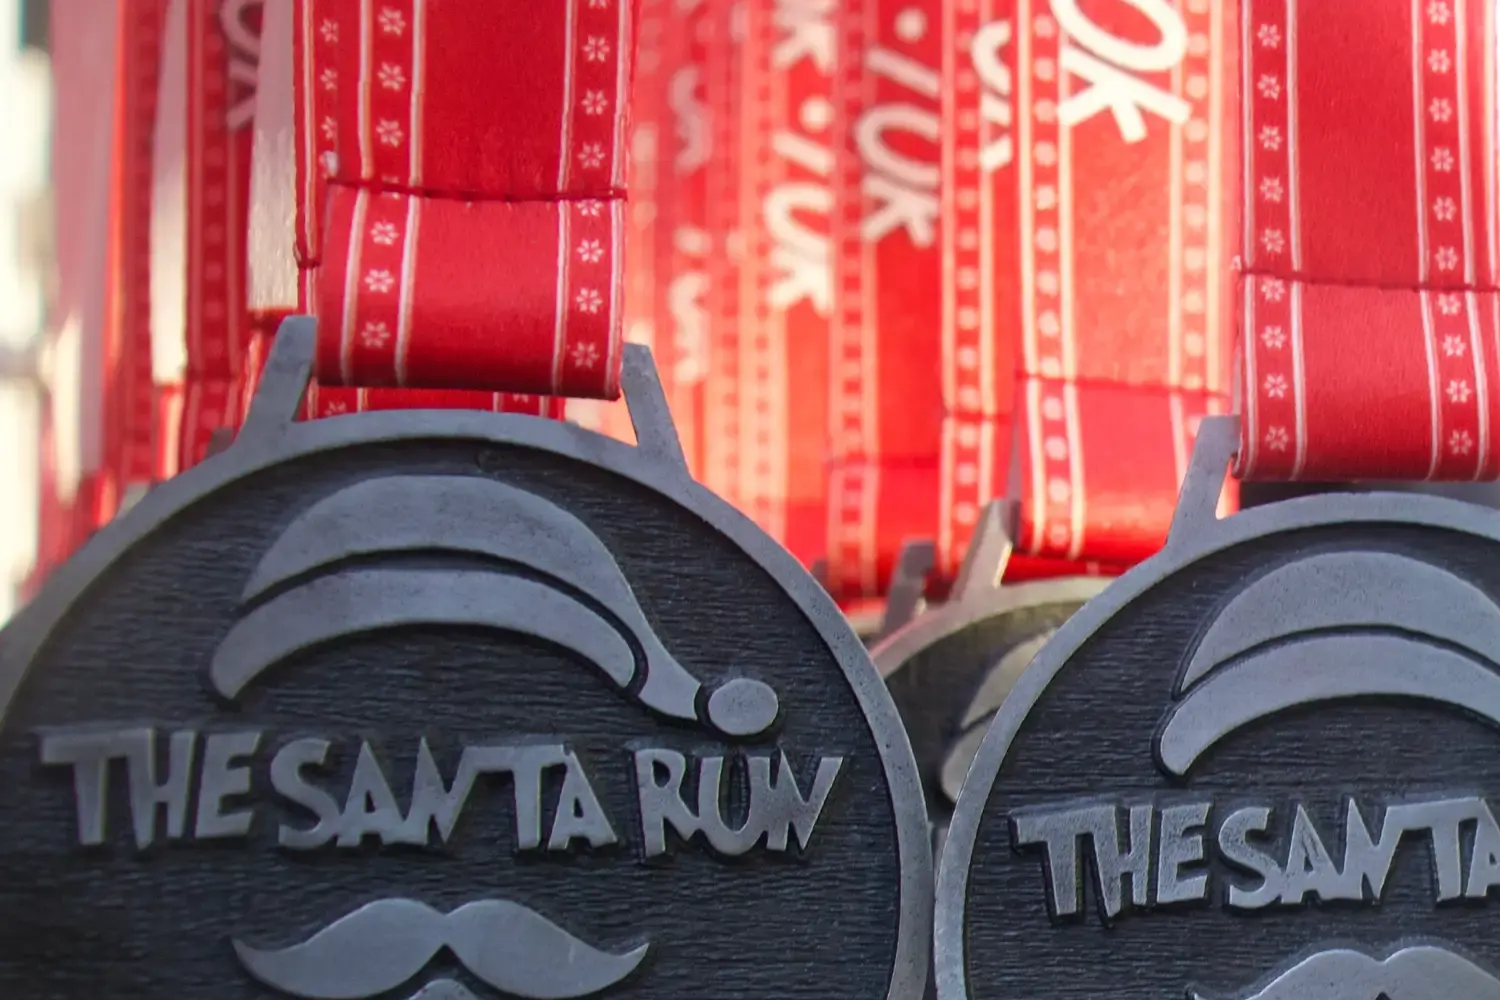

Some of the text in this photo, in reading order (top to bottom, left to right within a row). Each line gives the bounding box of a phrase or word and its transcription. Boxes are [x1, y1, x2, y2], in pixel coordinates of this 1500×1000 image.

[39, 727, 844, 857] THE SANTA RUN
[1011, 802, 1210, 923] THE
